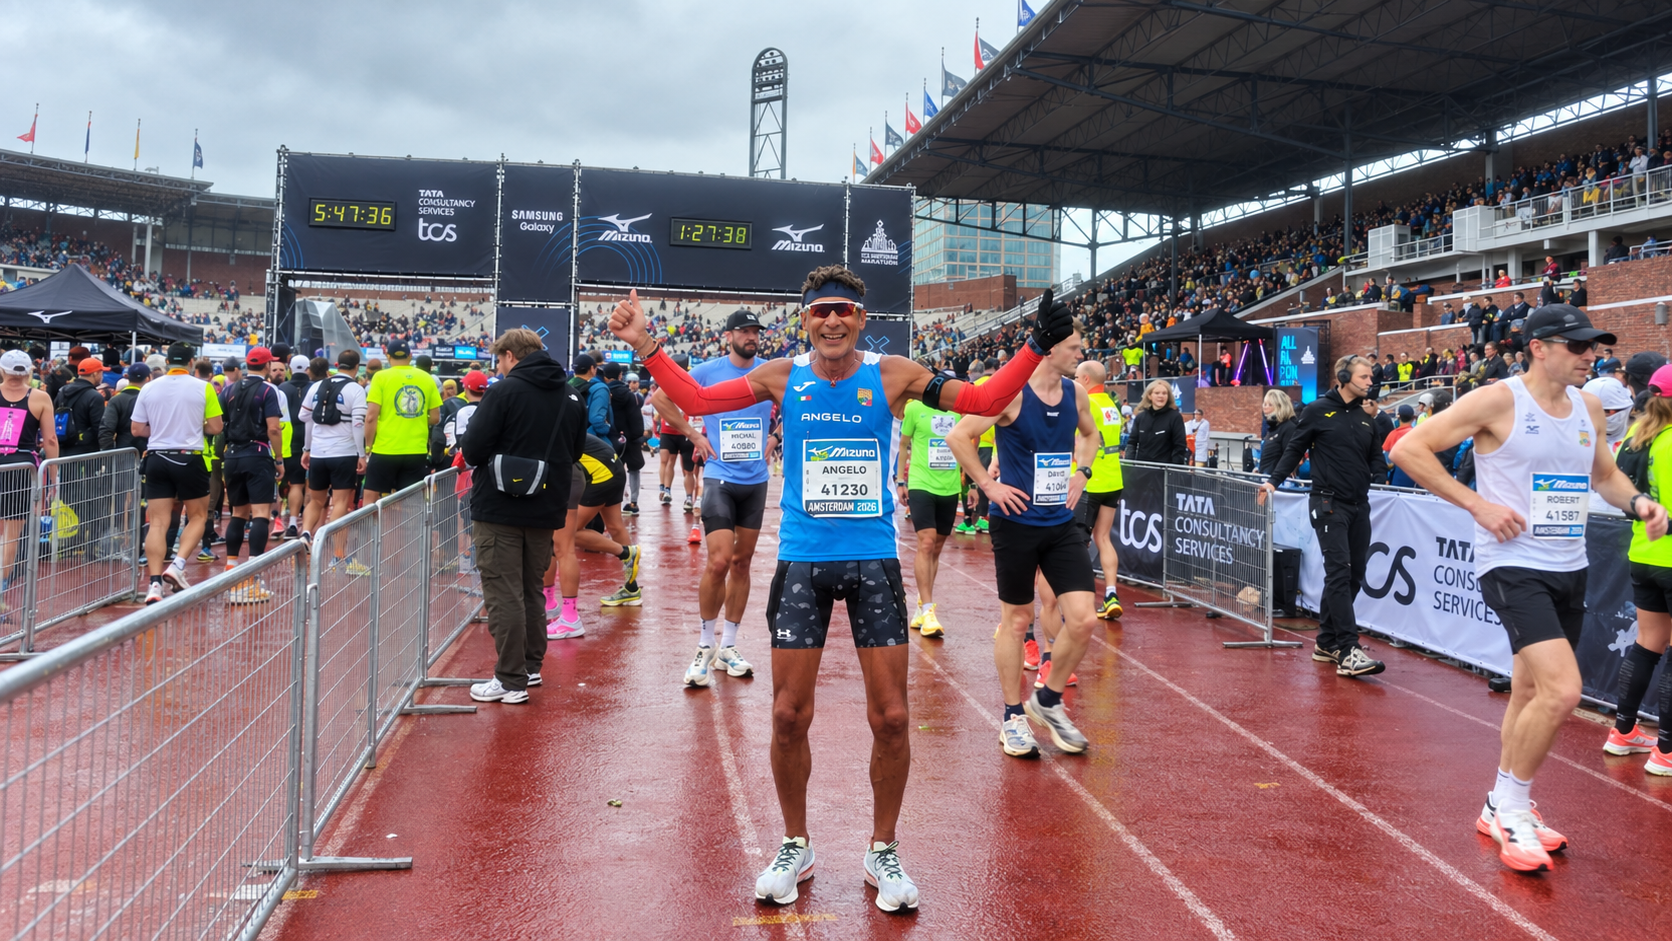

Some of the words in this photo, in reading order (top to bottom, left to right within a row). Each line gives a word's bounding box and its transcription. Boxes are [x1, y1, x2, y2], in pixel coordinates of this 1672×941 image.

[419, 190, 444, 198] TATA
[315, 204, 392, 225] 5:47:36
[418, 208, 455, 216] SERVICES
[511, 210, 563, 221] SAMSUNG
[418, 218, 457, 242] tcs
[520, 221, 555, 234] Galaxy
[680, 224, 747, 244] 1:27:38
[1281, 335, 1297, 349] ALL
[801, 413, 862, 424] ANGELO
[822, 465, 867, 475] ANGELO
[821, 483, 868, 496] 41230
[1175, 493, 1216, 516] TATA
[1547, 495, 1580, 504] ROBERT
[808, 502, 854, 512] AMSTERDAM
[1546, 510, 1580, 521] 41587
[1119, 498, 1162, 554] tcs
[1175, 516, 1265, 549] CONSULTANCY
[1175, 537, 1233, 565] SERVICES
[1360, 541, 1417, 606] cs
